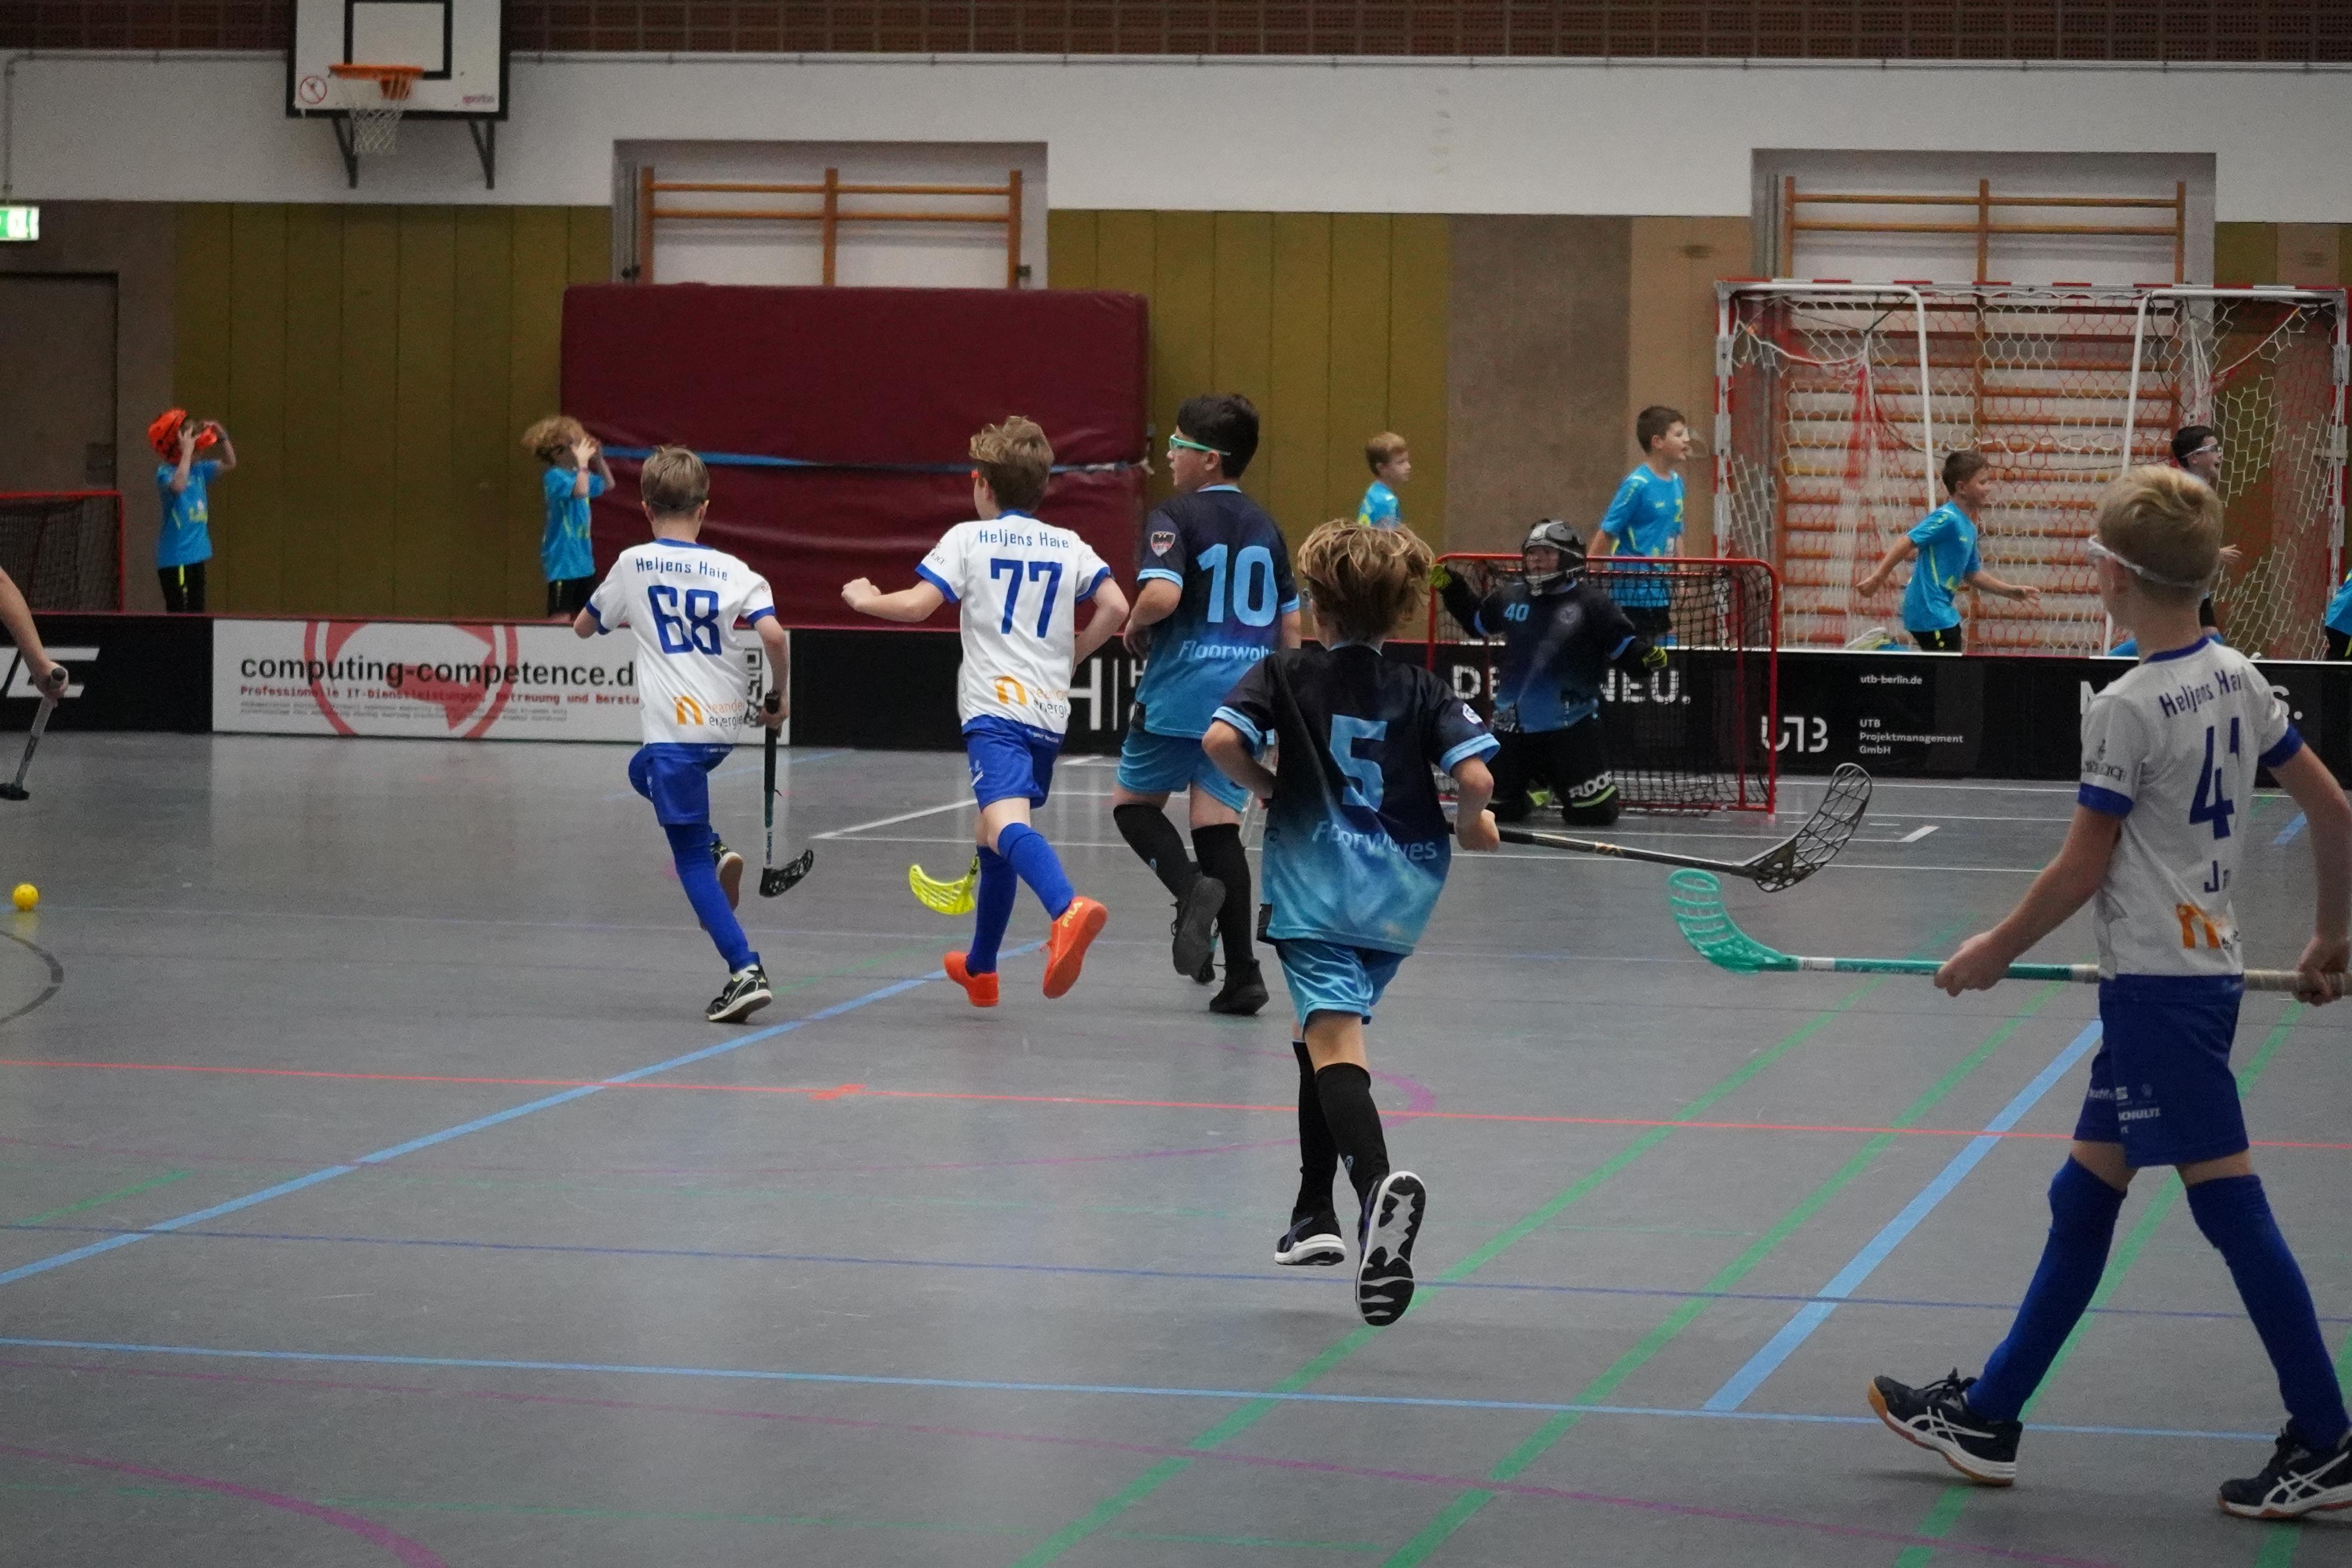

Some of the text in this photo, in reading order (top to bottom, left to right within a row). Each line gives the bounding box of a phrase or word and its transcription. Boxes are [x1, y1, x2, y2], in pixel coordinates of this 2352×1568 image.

[979, 529, 1069, 548] Heljens Haie
[636, 556, 727, 581] Heljens Haie
[1196, 543, 1278, 627] 10
[990, 558, 1062, 638] 77
[648, 585, 722, 656] 68
[1503, 602, 1530, 622] 40
[1860, 674, 1923, 685] utb-berlin.de
[1760, 715, 1829, 753] UTB
[1859, 718, 1881, 728] UTB
[1859, 731, 1964, 745] Projektmanagement
[1859, 745, 1891, 755] GmbH
[1330, 714, 1388, 813] 5
